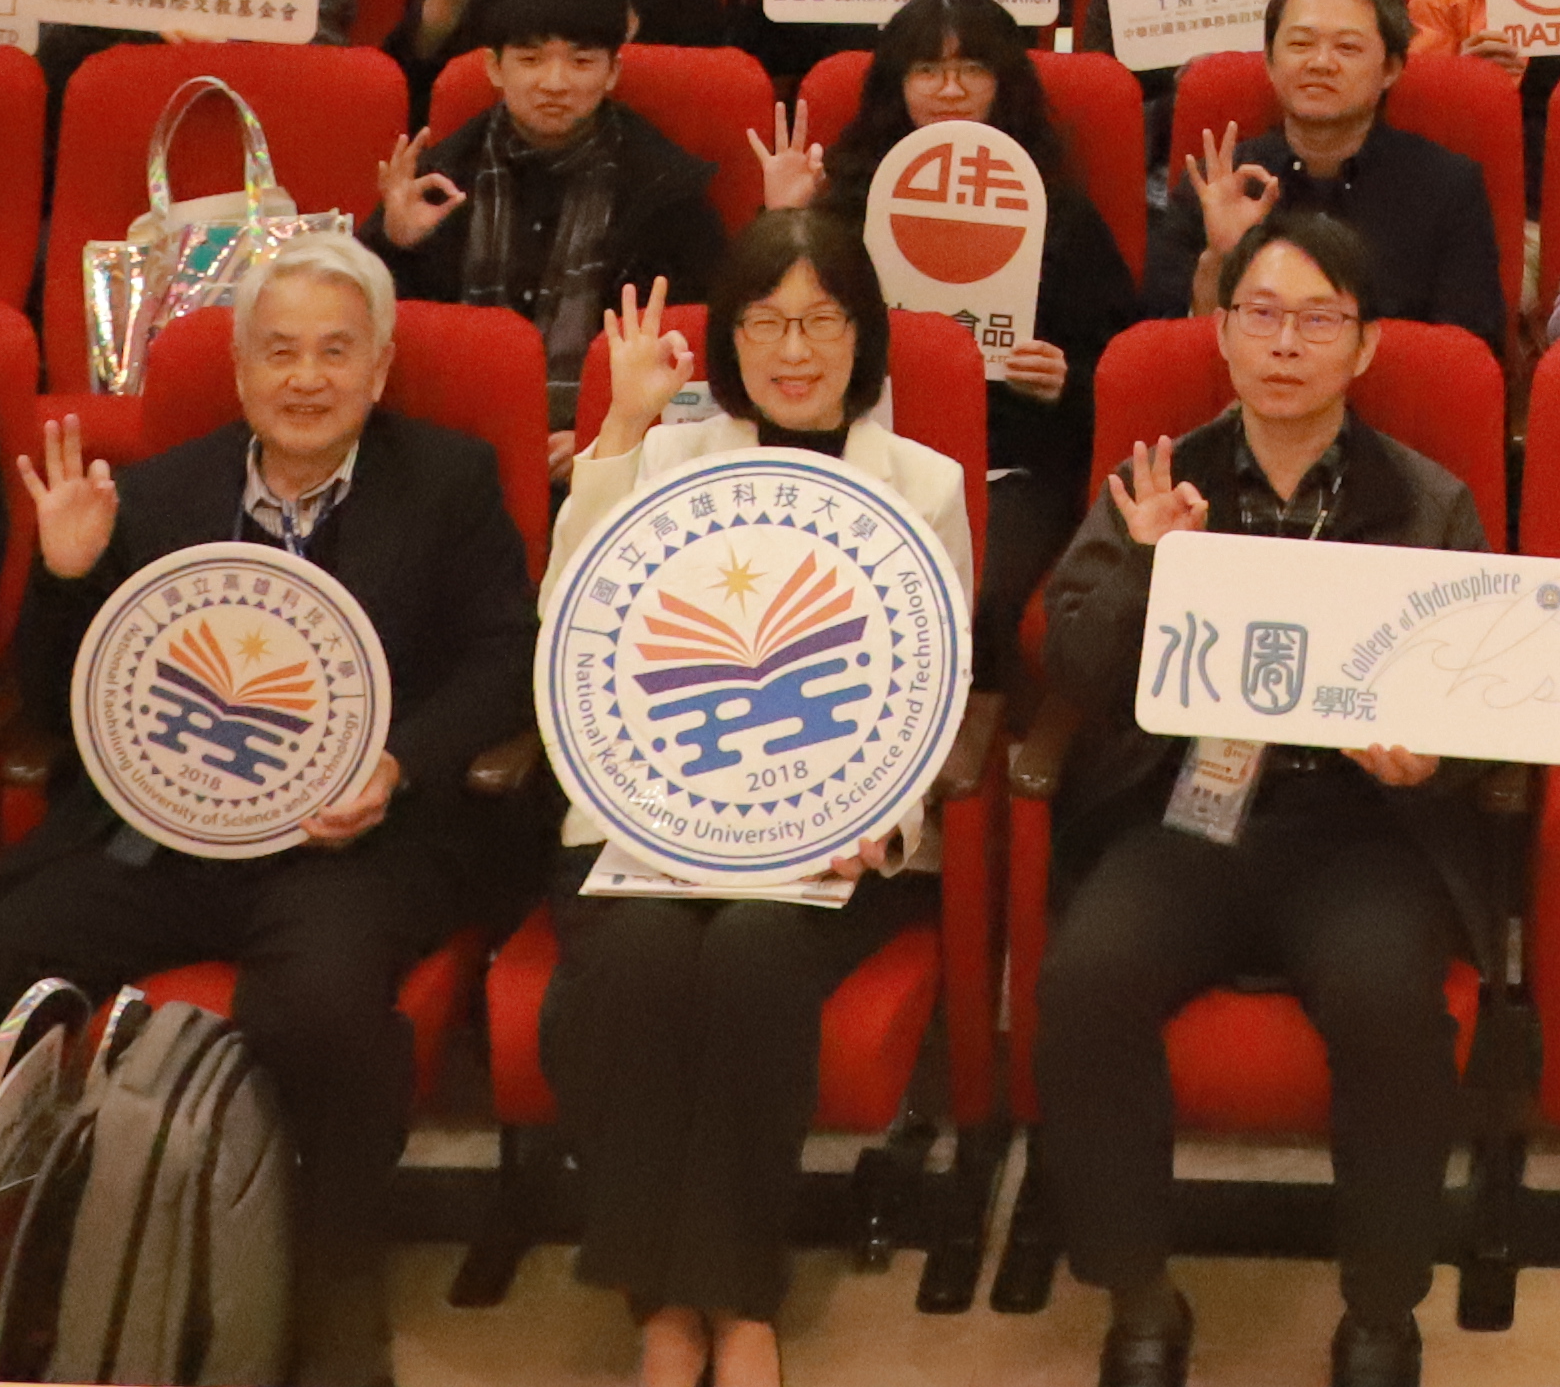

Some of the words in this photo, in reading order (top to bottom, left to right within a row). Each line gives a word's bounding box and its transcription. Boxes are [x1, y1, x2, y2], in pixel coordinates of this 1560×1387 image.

[589, 482, 879, 605] 國立高雄科技大學
[160, 572, 358, 680] 國立高雄科技大學
[896, 569, 931, 706] Technology
[1341, 621, 1400, 683] College
[1407, 567, 1522, 619] Hydrosphere
[576, 652, 608, 748] National
[897, 707, 925, 743] and
[131, 770, 198, 826] University
[221, 806, 282, 827] Science
[283, 788, 313, 813] and
[310, 710, 361, 795] Technology
[597, 748, 688, 836] Kaohsiung
[746, 760, 810, 793] 2018
[835, 746, 903, 814] Science
[693, 820, 806, 845] University
[811, 802, 838, 828] of
